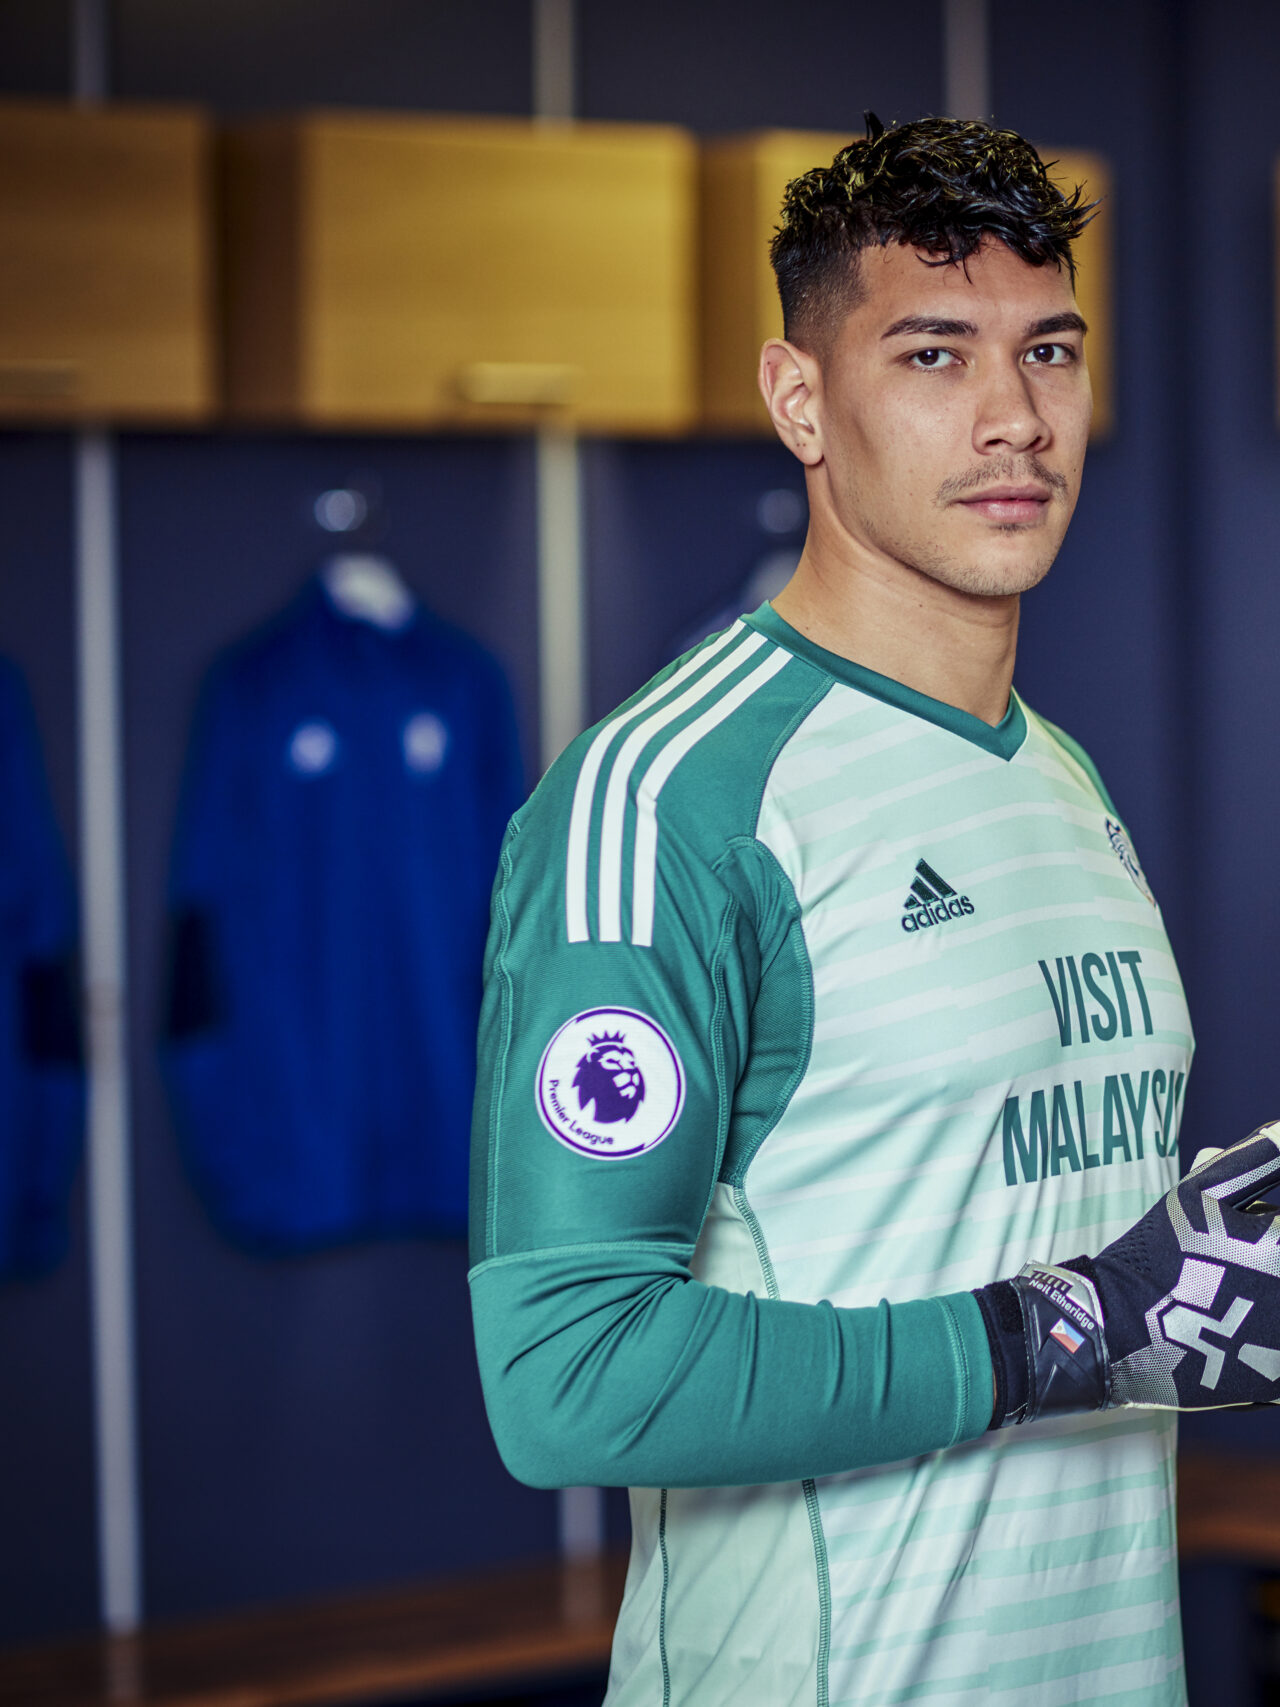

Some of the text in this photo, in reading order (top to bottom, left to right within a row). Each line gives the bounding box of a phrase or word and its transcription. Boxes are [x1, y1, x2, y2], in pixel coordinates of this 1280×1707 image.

[902, 895, 975, 933] adidas
[1038, 950, 1154, 1047] VISIT
[549, 1079, 614, 1144] Premier League
[1029, 1279, 1052, 1295] Neil
[1050, 1289, 1095, 1330] Etheridge
